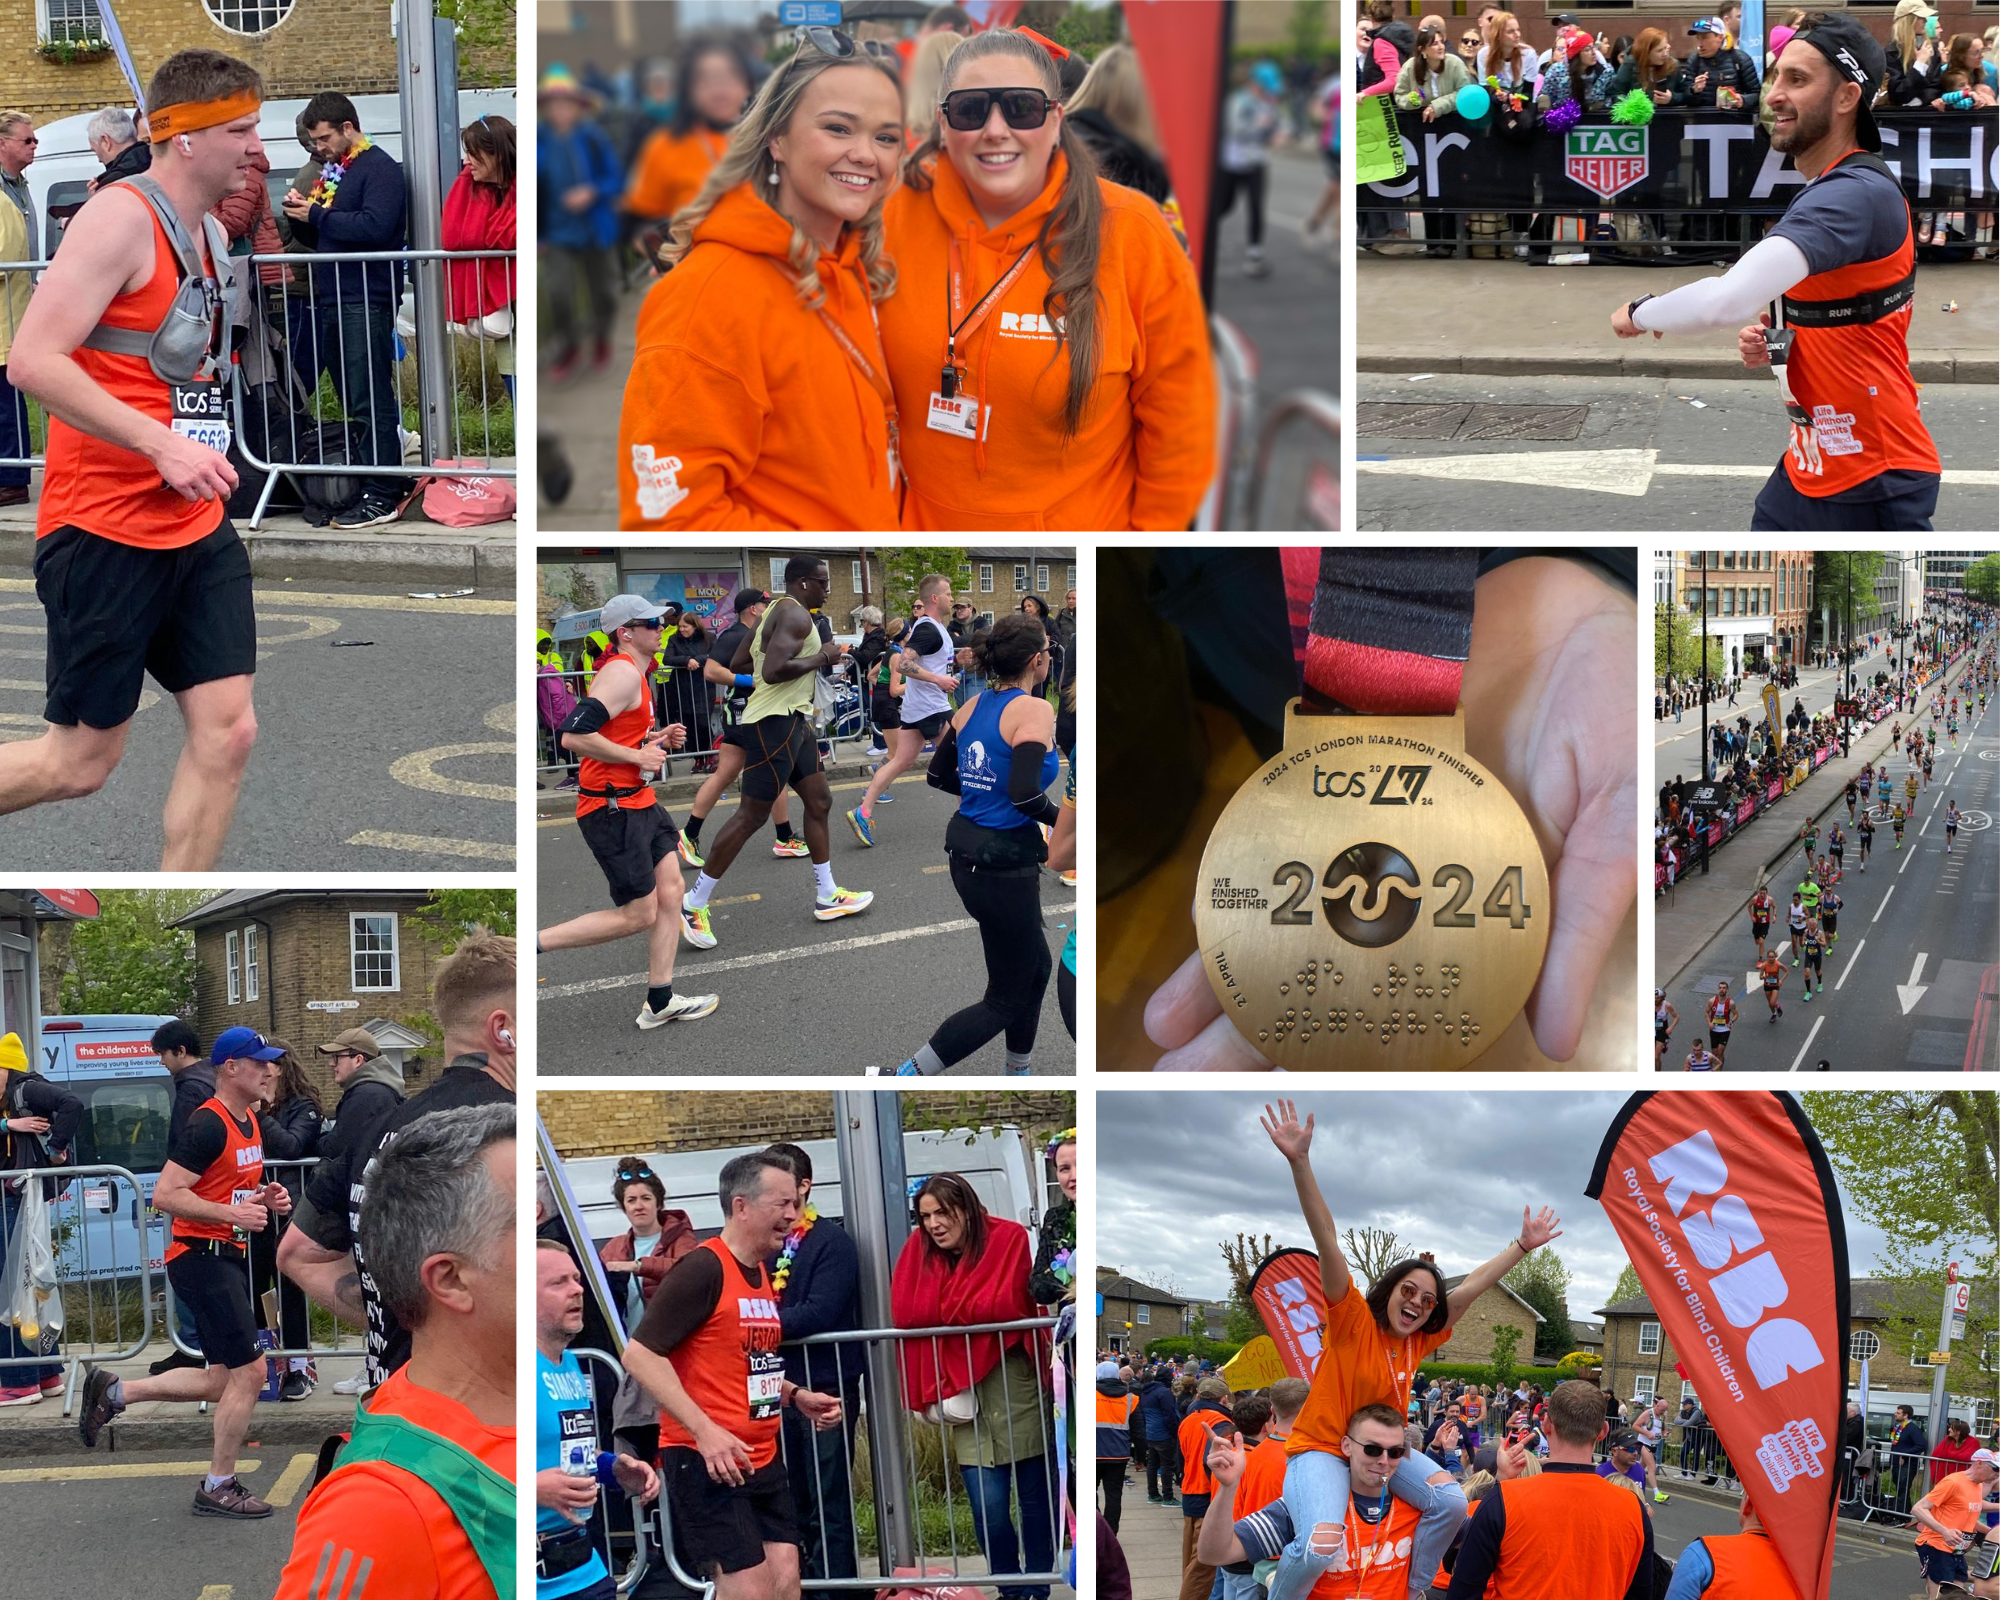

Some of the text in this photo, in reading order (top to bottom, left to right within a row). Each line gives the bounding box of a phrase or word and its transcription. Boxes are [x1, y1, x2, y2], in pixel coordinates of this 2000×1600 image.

[1572, 131, 1641, 153] TAG
[1392, 151, 1404, 176] KEEP
[1571, 160, 1643, 193] HEUER
[977, 304, 988, 316] The
[985, 287, 1002, 305] Royal
[999, 268, 1018, 289] Society
[175, 386, 208, 413] tcs
[932, 397, 962, 415] RSBC
[1815, 414, 1852, 426] Without
[1817, 406, 1832, 417] Life
[1820, 426, 1849, 436] Limits
[697, 588, 724, 596] MOVE
[695, 604, 709, 612] ON
[712, 618, 723, 627] UP
[1837, 702, 1857, 714] tcs
[1262, 735, 1485, 788] 2024 TCS LONDON MARATHON FINISHER
[962, 780, 992, 791] STRIDERS
[1313, 764, 1366, 798] tcs
[1214, 877, 1231, 888] WE
[1211, 888, 1259, 899] FINISHED
[1211, 899, 1269, 910] TOGETHER
[1215, 951, 1237, 988] APRIL
[79, 1047, 95, 1056] the
[97, 1044, 138, 1055] children's
[130, 1059, 144, 1067] lives
[1647, 1129, 1825, 1391] RSBC
[1622, 1166, 1745, 1403] Royal Society for Blind Children
[1262, 1286, 1276, 1307] Royal
[1271, 1305, 1287, 1331] Society
[1283, 1329, 1291, 1341] for
[1287, 1340, 1300, 1359] Blind
[1244, 1342, 1266, 1361] GO
[749, 1355, 768, 1372] tcs
[760, 1376, 781, 1396] 8172
[1803, 1424, 1820, 1447] Life
[1765, 1438, 1792, 1477] For Blind
[1778, 1434, 1803, 1472] Limits
[1788, 1424, 1821, 1474] Without
[1760, 1450, 1785, 1490] Children
